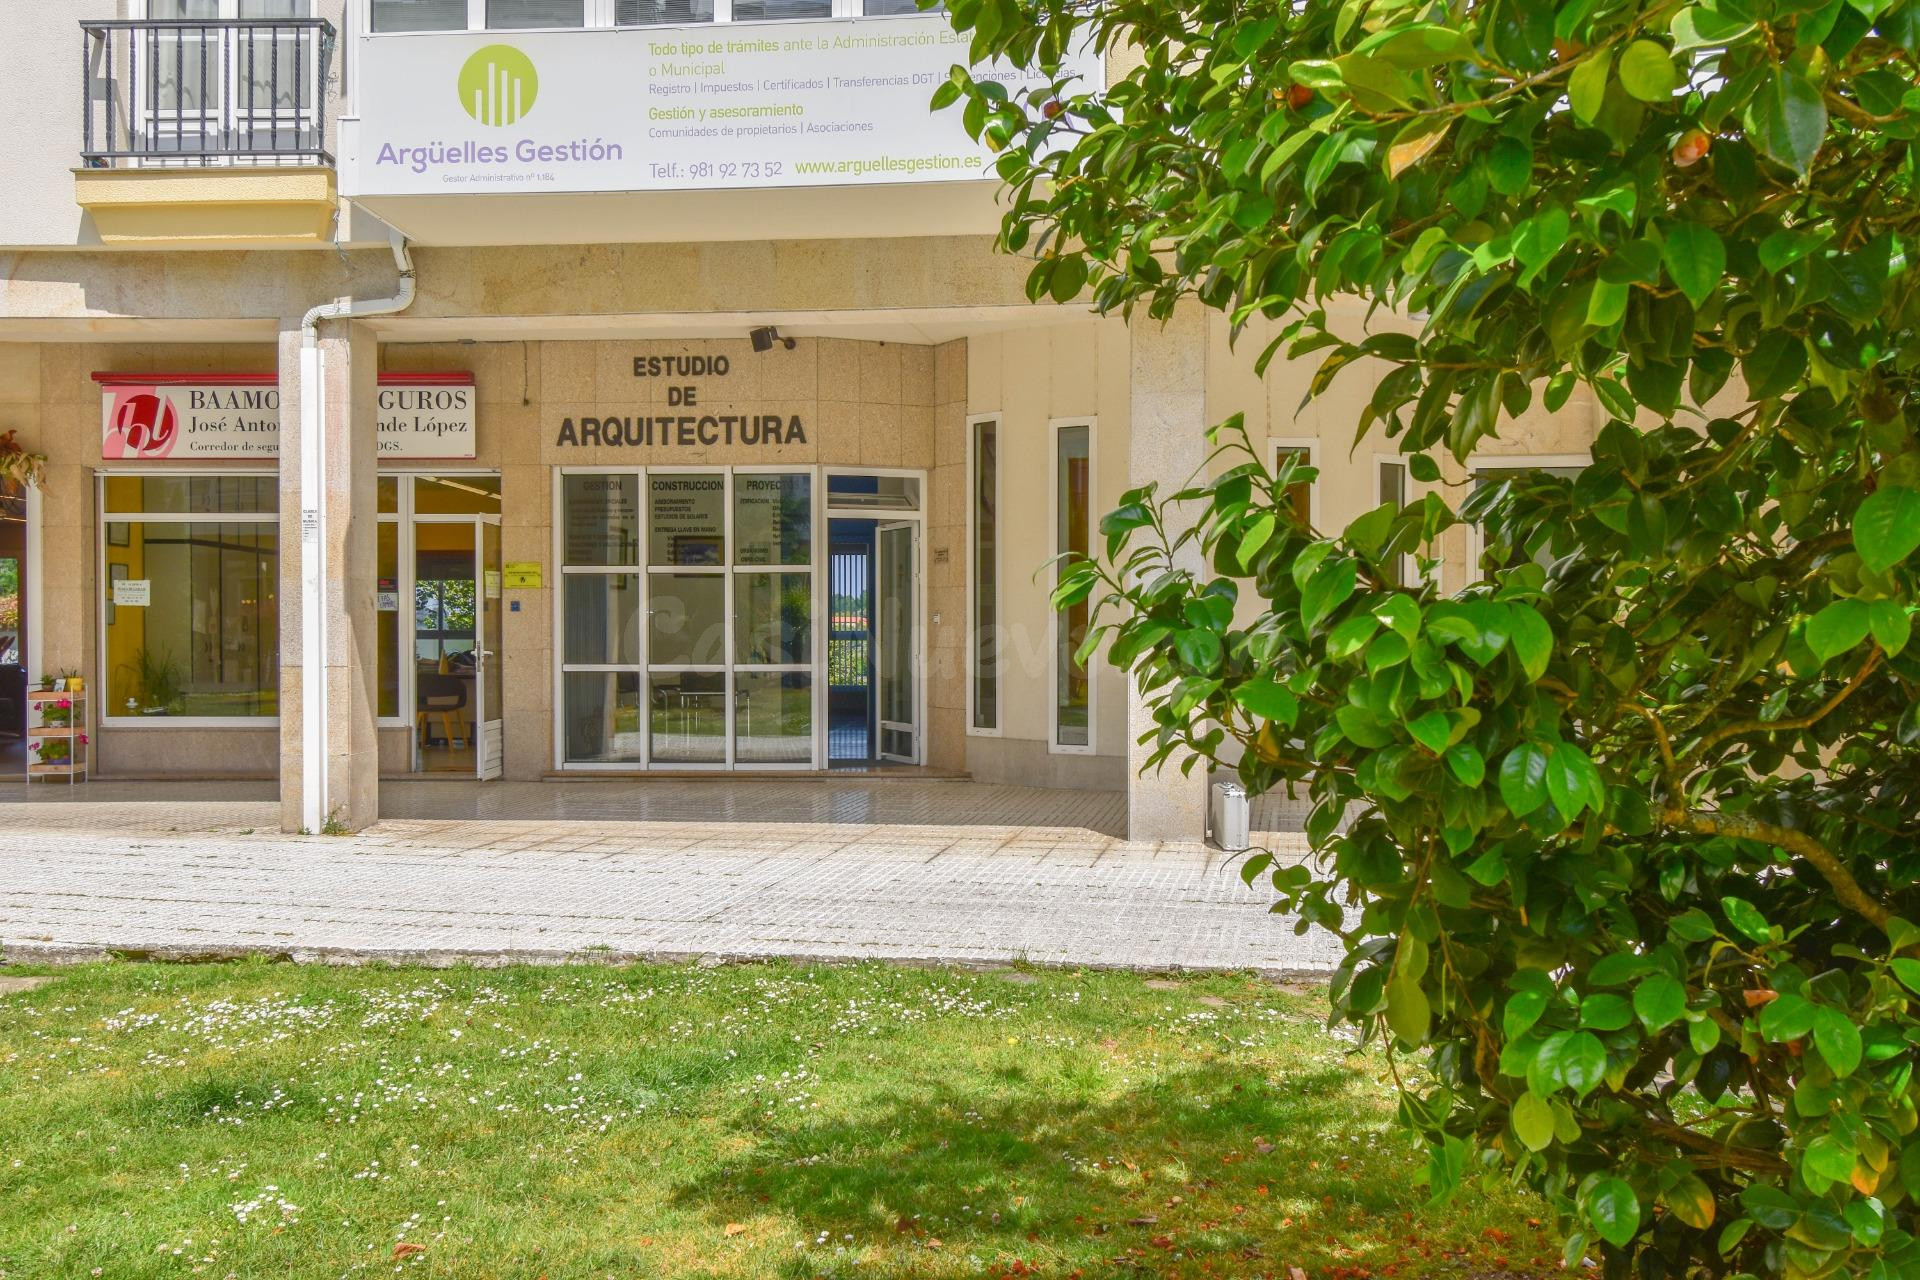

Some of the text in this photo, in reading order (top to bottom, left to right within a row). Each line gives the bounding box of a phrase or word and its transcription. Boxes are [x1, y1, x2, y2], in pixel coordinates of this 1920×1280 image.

[648, 43, 677, 56] Todo
[681, 42, 703, 57] tipo
[708, 40, 723, 53] de
[727, 39, 779, 53] trámites
[783, 39, 812, 51] ante
[818, 36, 829, 49] la
[833, 33, 934, 49] Administración
[649, 61, 725, 77] o Municipal
[649, 83, 691, 97] Registro
[700, 81, 753, 95] Impuestos
[763, 79, 823, 91] Certificados
[833, 75, 909, 89] Transferencias
[912, 73, 934, 85] DGT
[649, 103, 803, 122] Gestión y asesoramiento
[649, 122, 873, 138] Comunidades de propietarios Asociaciones
[376, 137, 622, 173] Argüelles Gestión
[649, 154, 982, 178] Telf.: 981 92 73 52 www.arguellesgestion.es
[442, 174, 467, 182] Gestor
[470, 173, 526, 182] Administrativo
[633, 356, 730, 377] ESTUDIO
[668, 386, 697, 407] DE
[189, 416, 227, 438] José
[414, 416, 467, 441] López
[556, 415, 808, 448] ARQUITECTURA
[190, 441, 239, 452] Corredor
[242, 441, 254, 452] de
[652, 481, 724, 491] CONSTRUCCION
